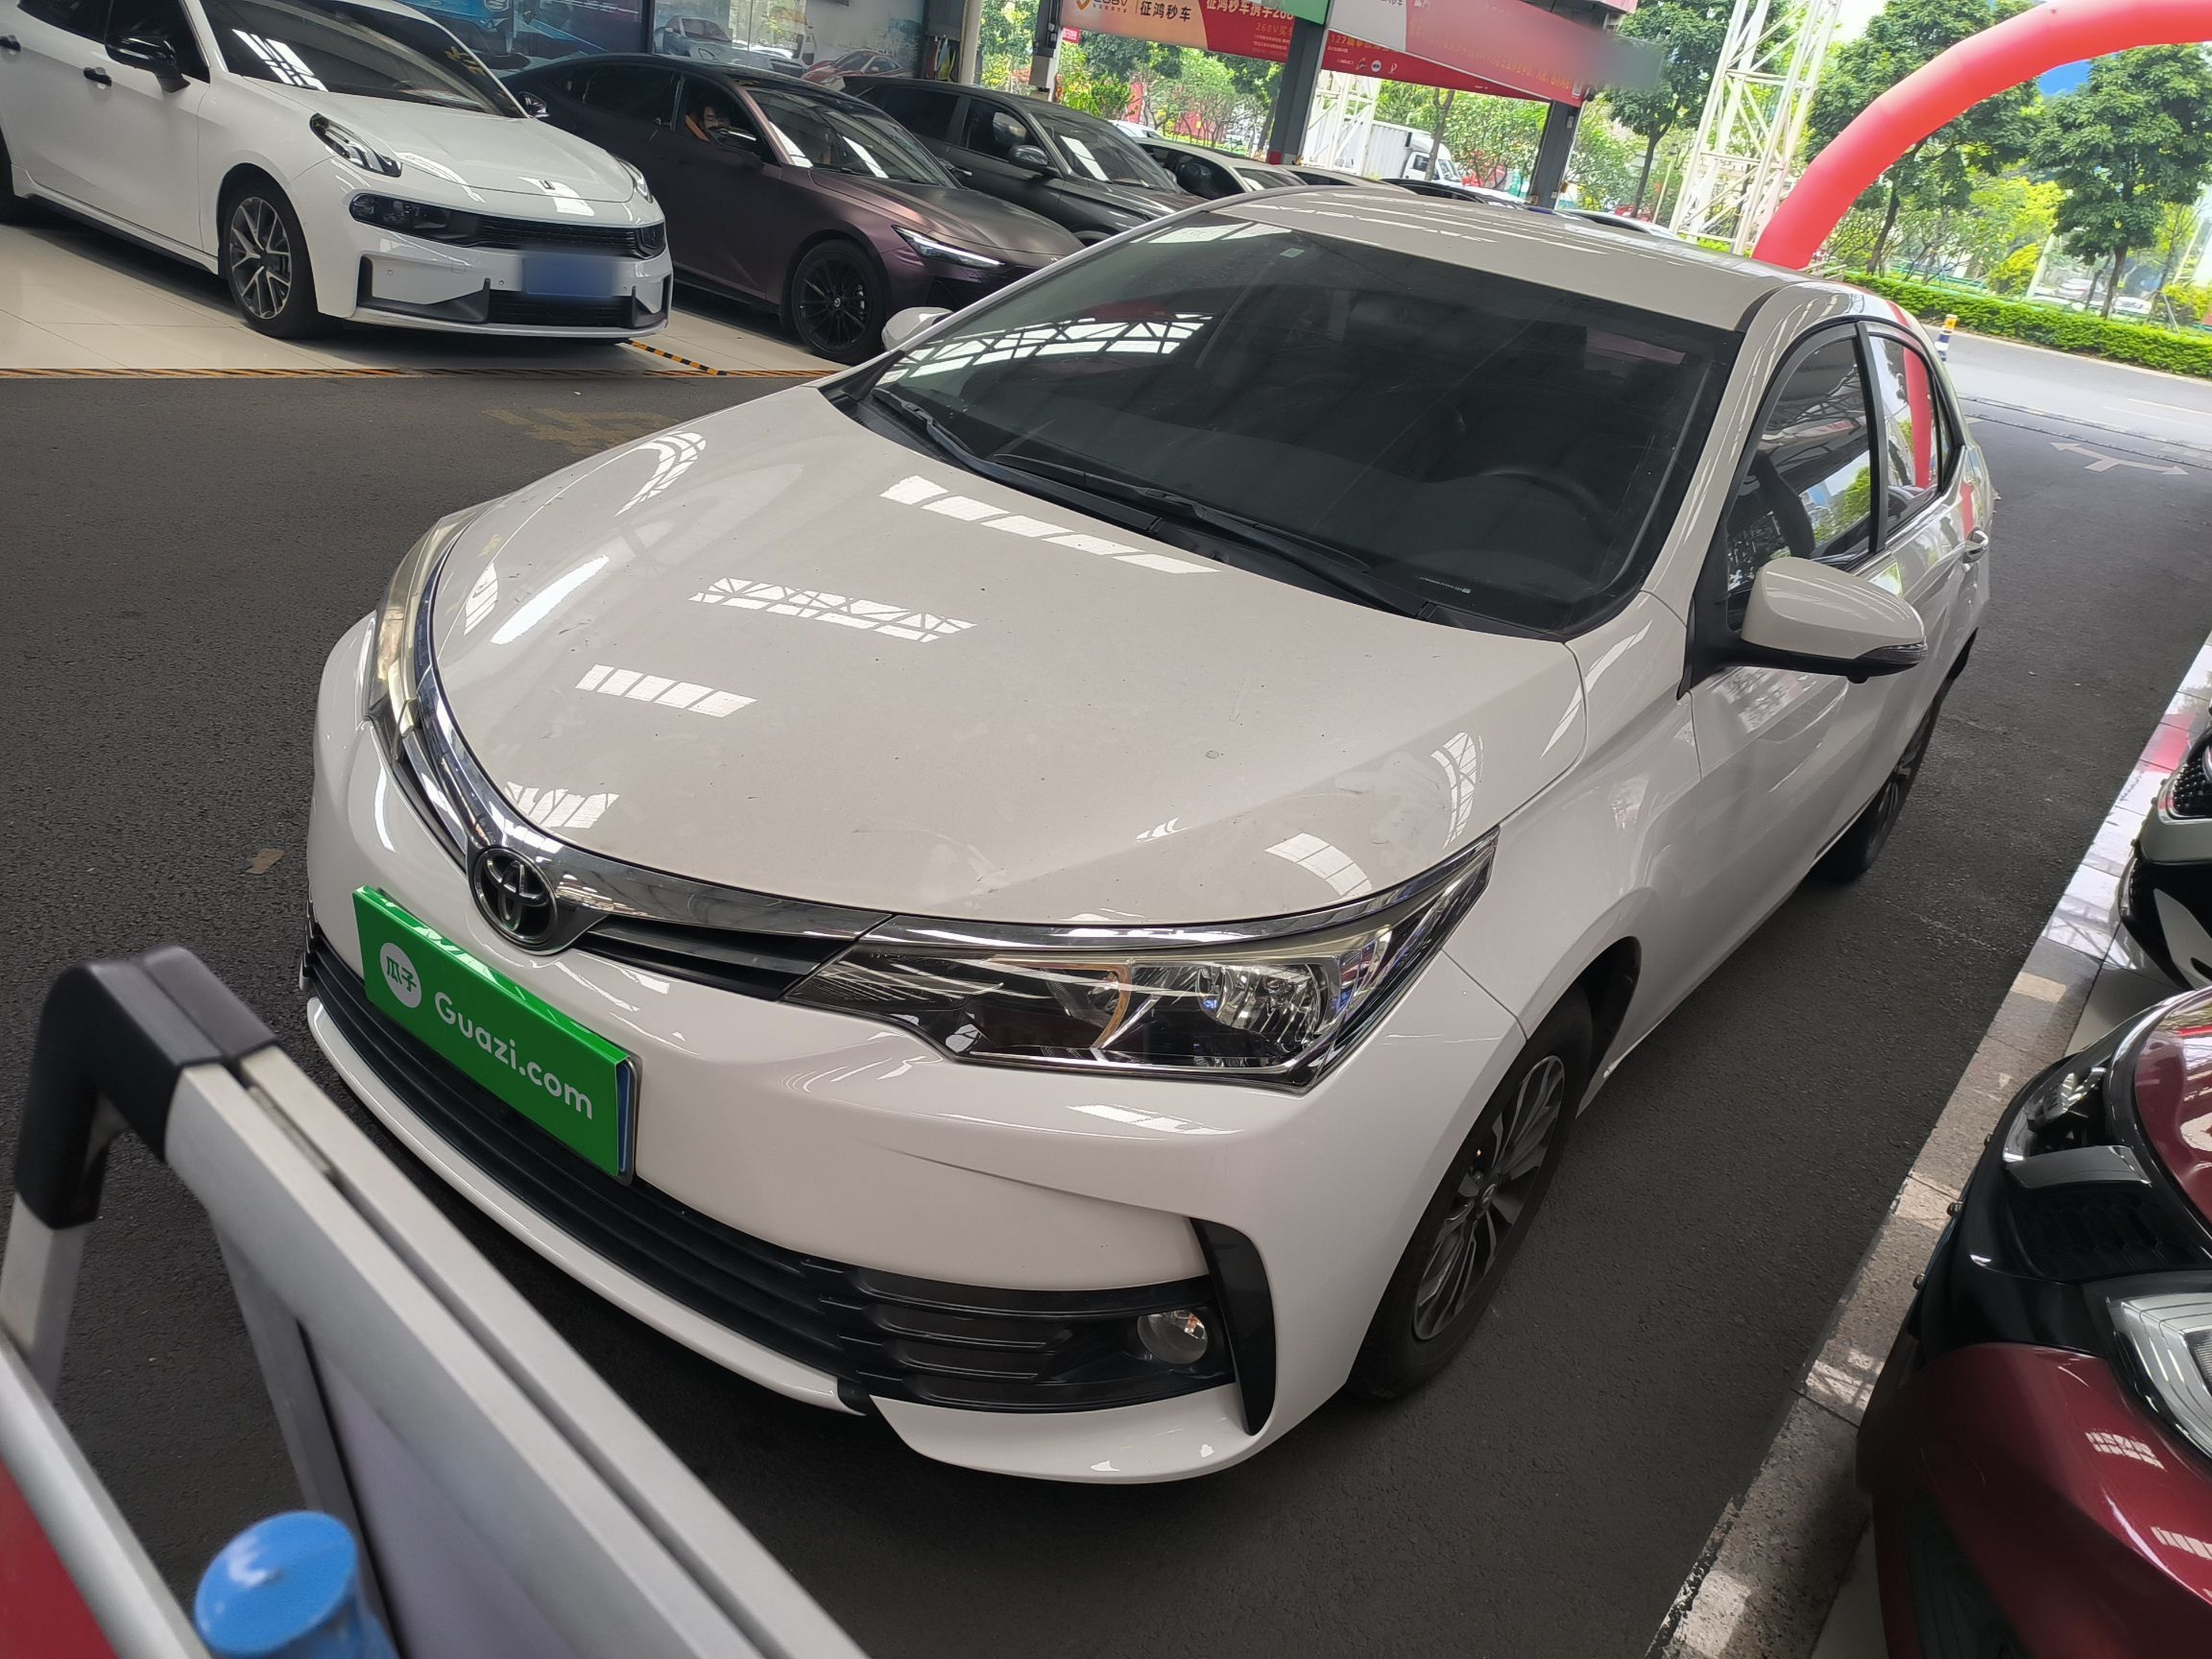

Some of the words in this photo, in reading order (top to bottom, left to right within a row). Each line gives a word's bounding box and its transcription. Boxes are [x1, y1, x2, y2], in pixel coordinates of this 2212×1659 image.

[1140, 1, 1191, 22] 征鸿秒车
[386, 956, 416, 992] 瓜子
[434, 992, 593, 1120] Guazi.com
